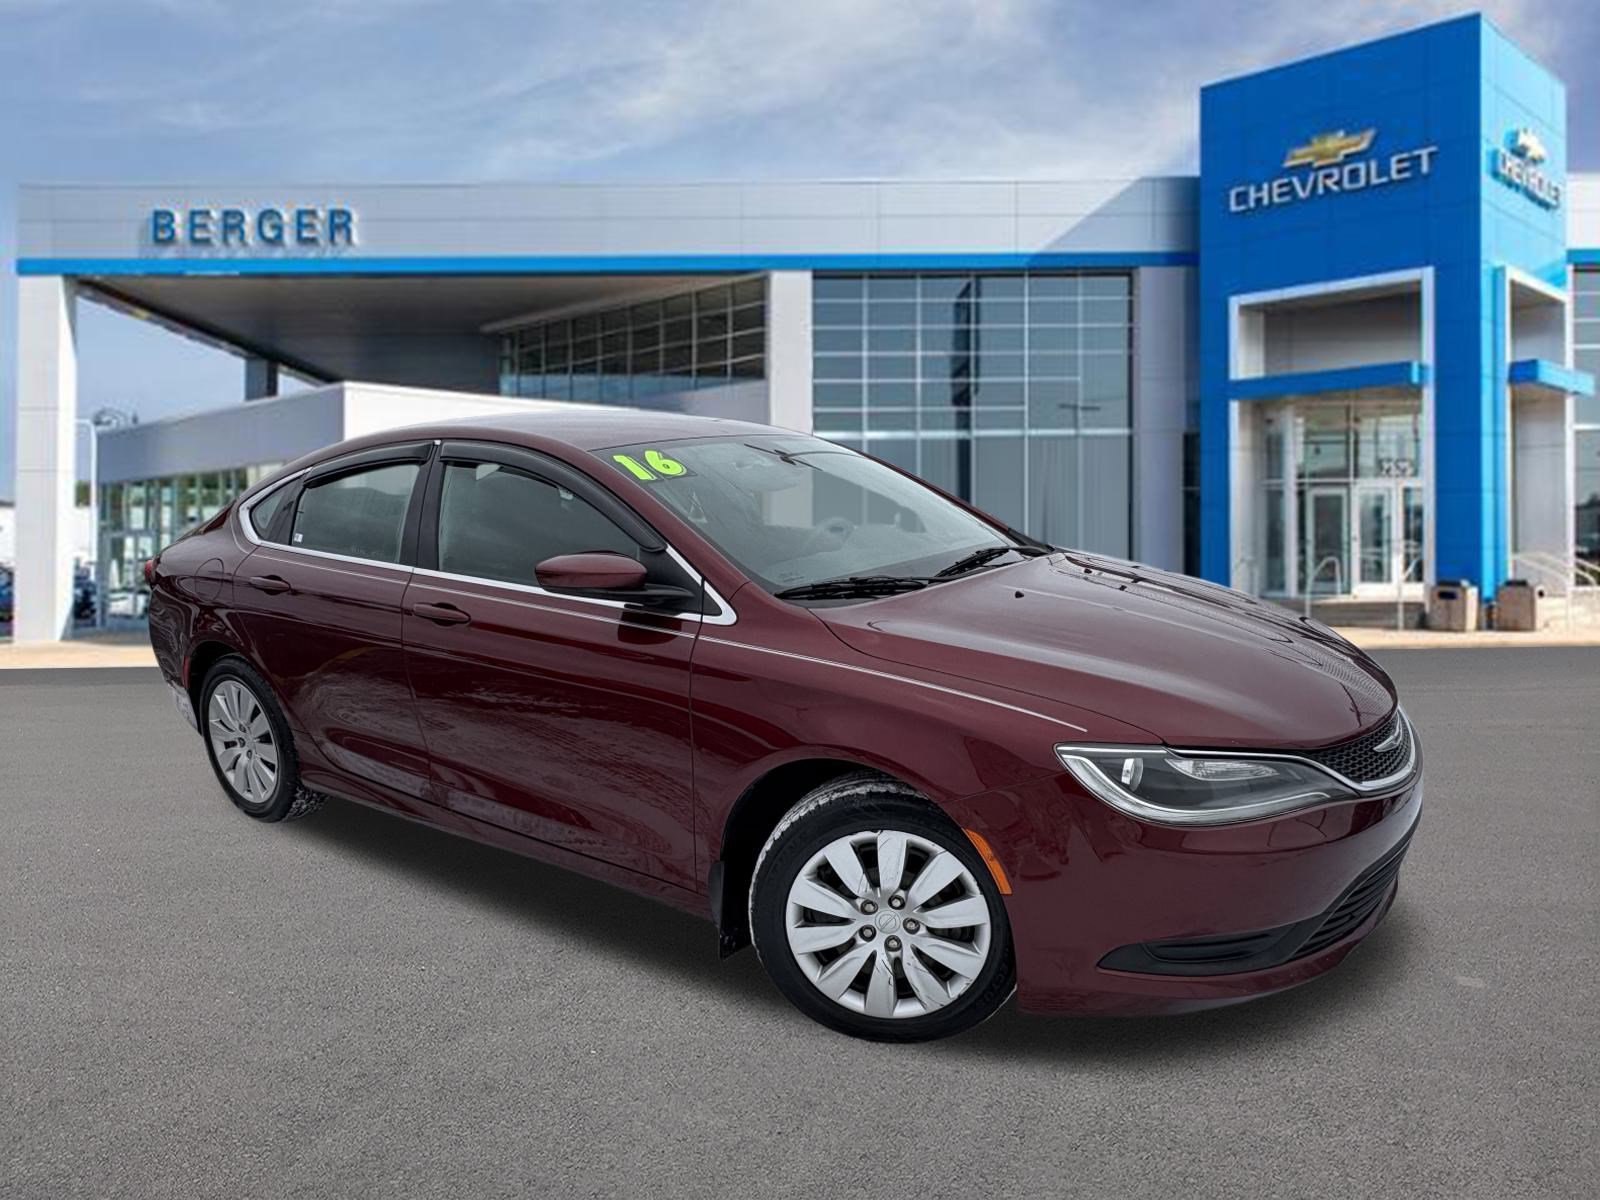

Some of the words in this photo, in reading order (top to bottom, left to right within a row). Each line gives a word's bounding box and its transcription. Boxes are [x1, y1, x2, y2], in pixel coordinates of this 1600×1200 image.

[1229, 146, 1438, 212] CHEVROLET
[152, 208, 355, 245] BERGER
[612, 450, 688, 480] 16
